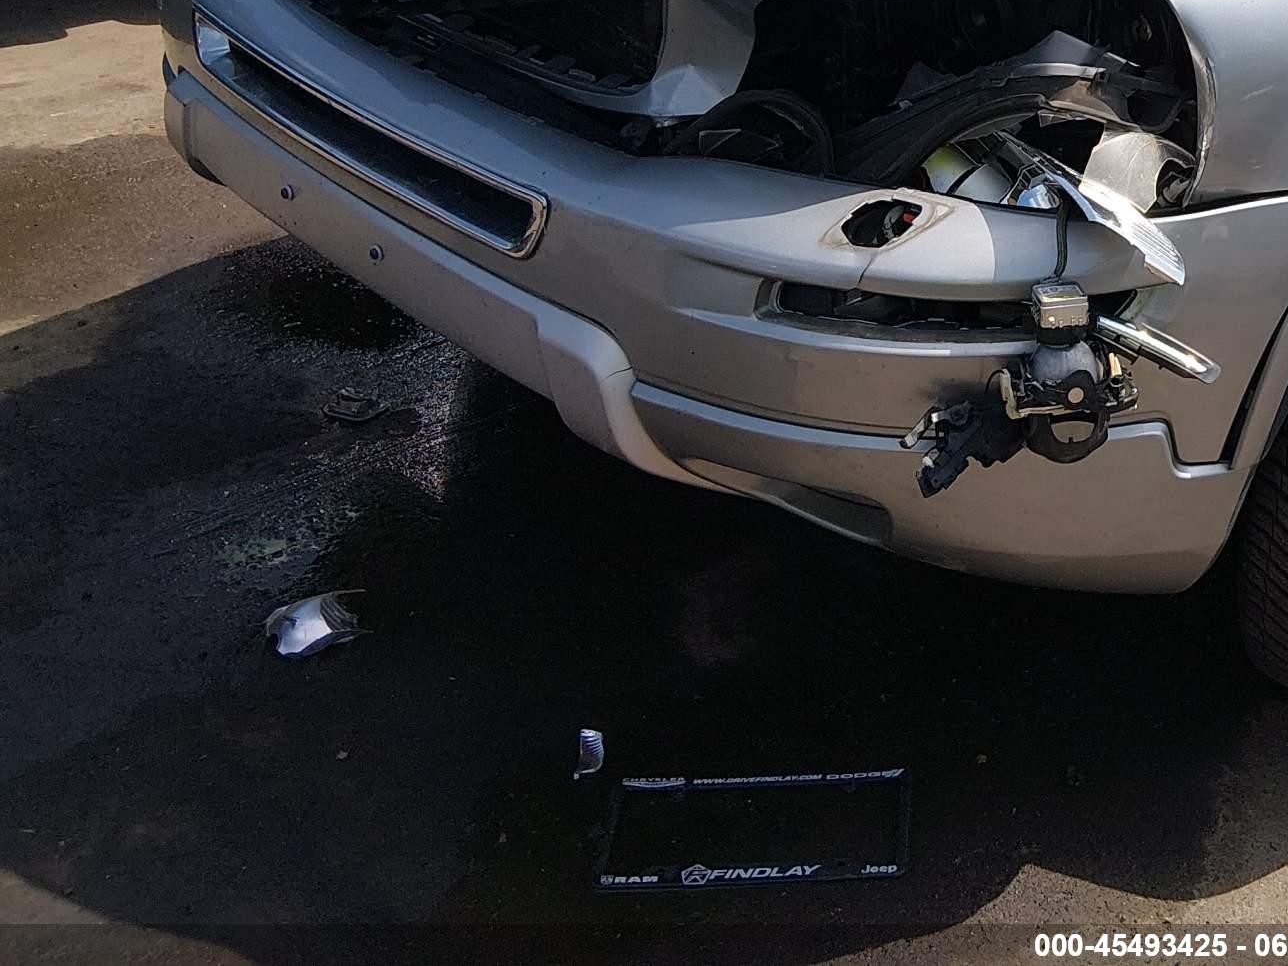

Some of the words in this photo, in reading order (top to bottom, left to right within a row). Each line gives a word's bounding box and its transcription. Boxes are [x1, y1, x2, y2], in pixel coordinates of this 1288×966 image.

[826, 771, 893, 780] DODGE
[708, 864, 821, 880] FINDLAY
[861, 864, 898, 874] Jeep
